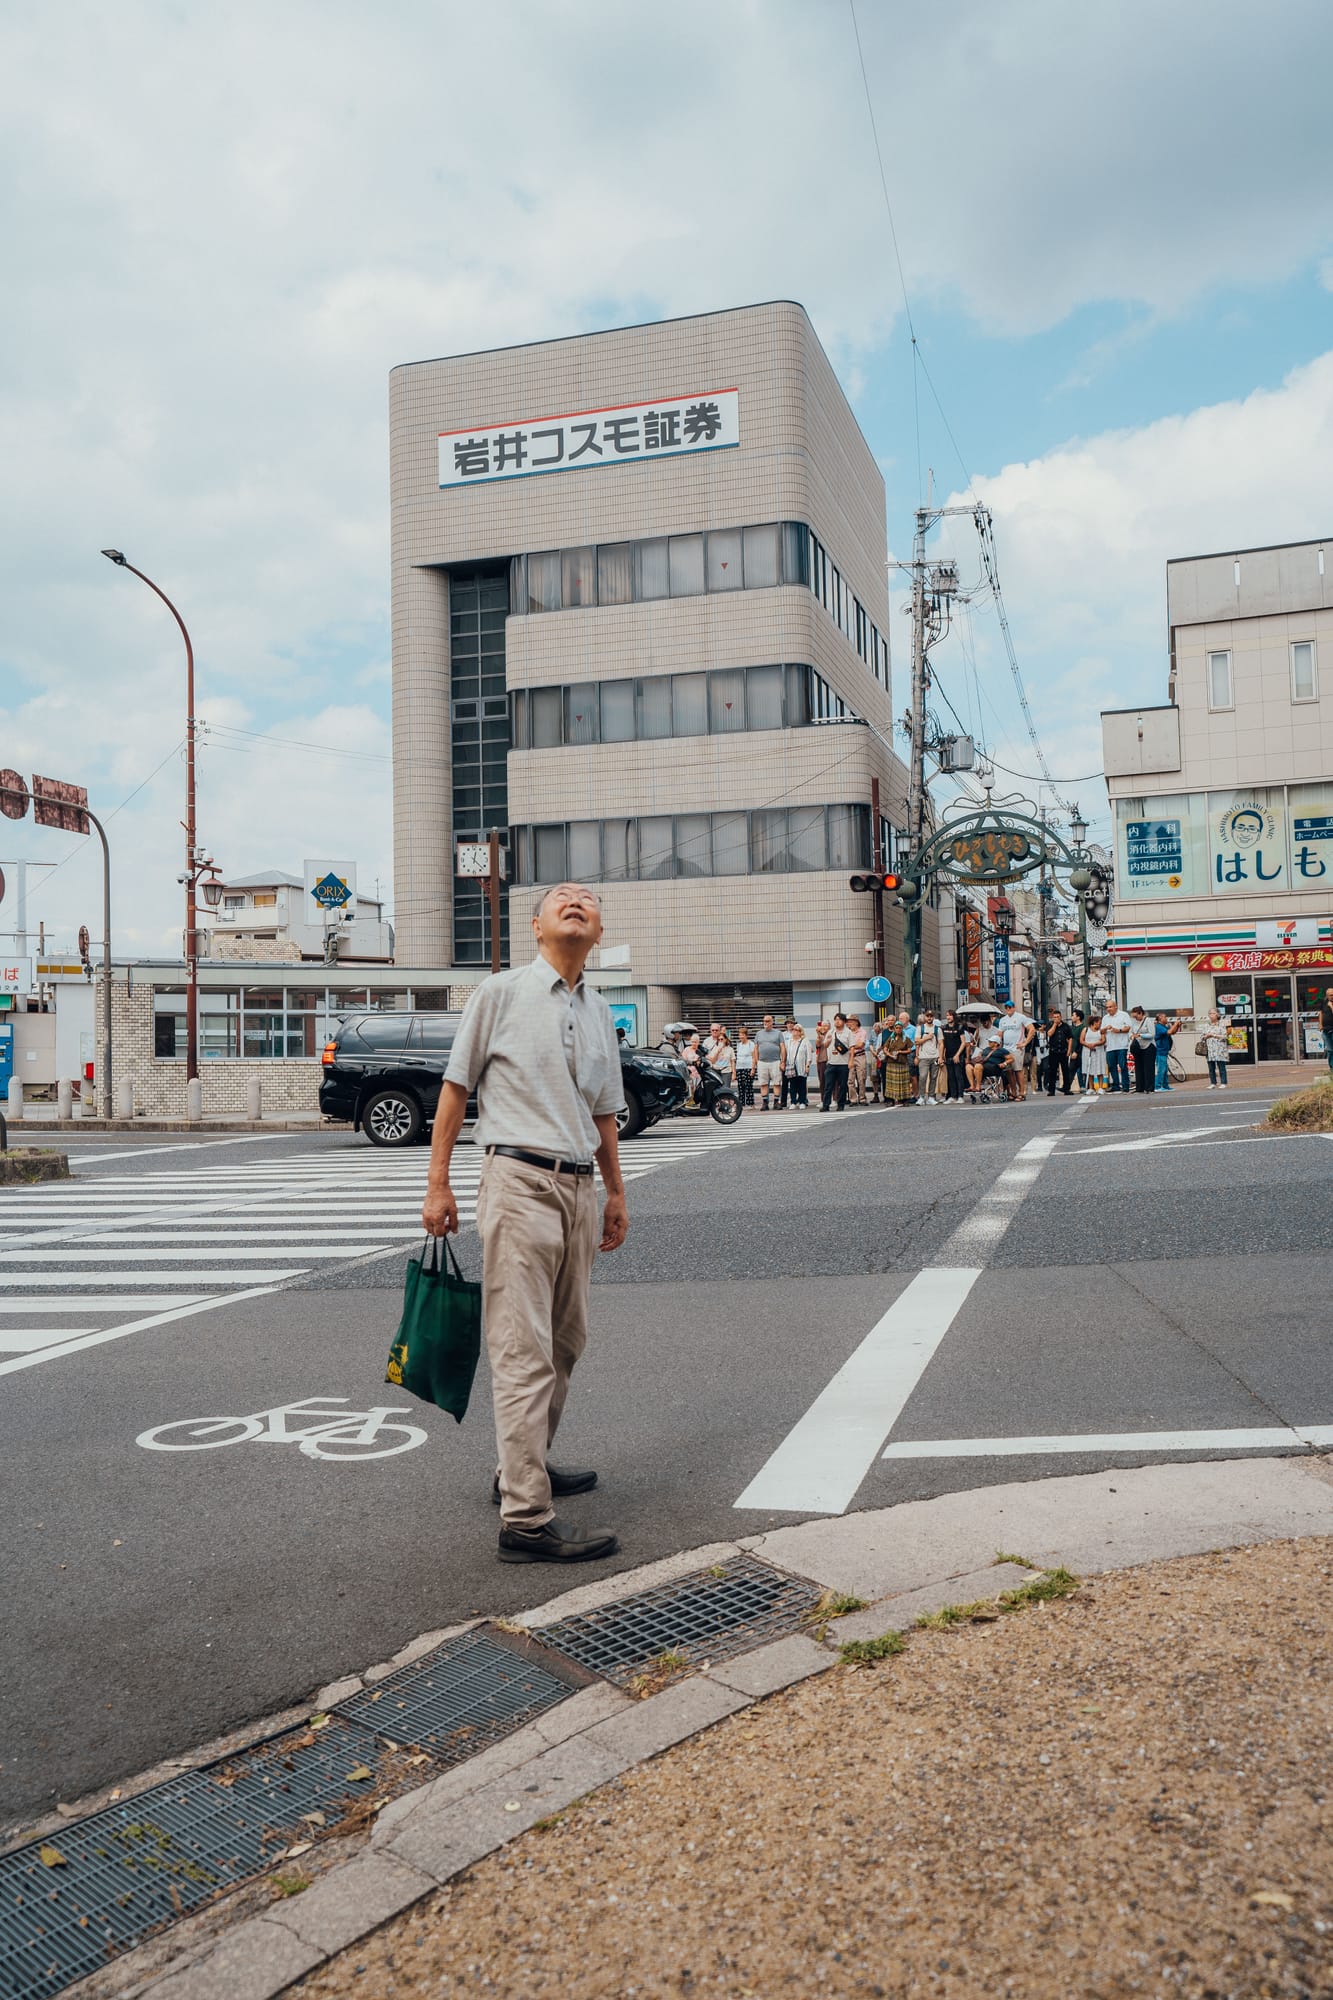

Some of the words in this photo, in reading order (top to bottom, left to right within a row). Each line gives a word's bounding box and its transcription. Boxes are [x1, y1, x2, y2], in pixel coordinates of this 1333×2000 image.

[454, 401, 722, 477] 岩井コスモ証券
[1242, 802, 1267, 815] FAMILY
[1129, 842, 1177, 855] 消化器内科
[1130, 859, 1178, 872] 内視鏡内科
[1216, 846, 1327, 883] はしも
[316, 886, 345, 897] ORIX
[0, 967, 19, 981] ば
